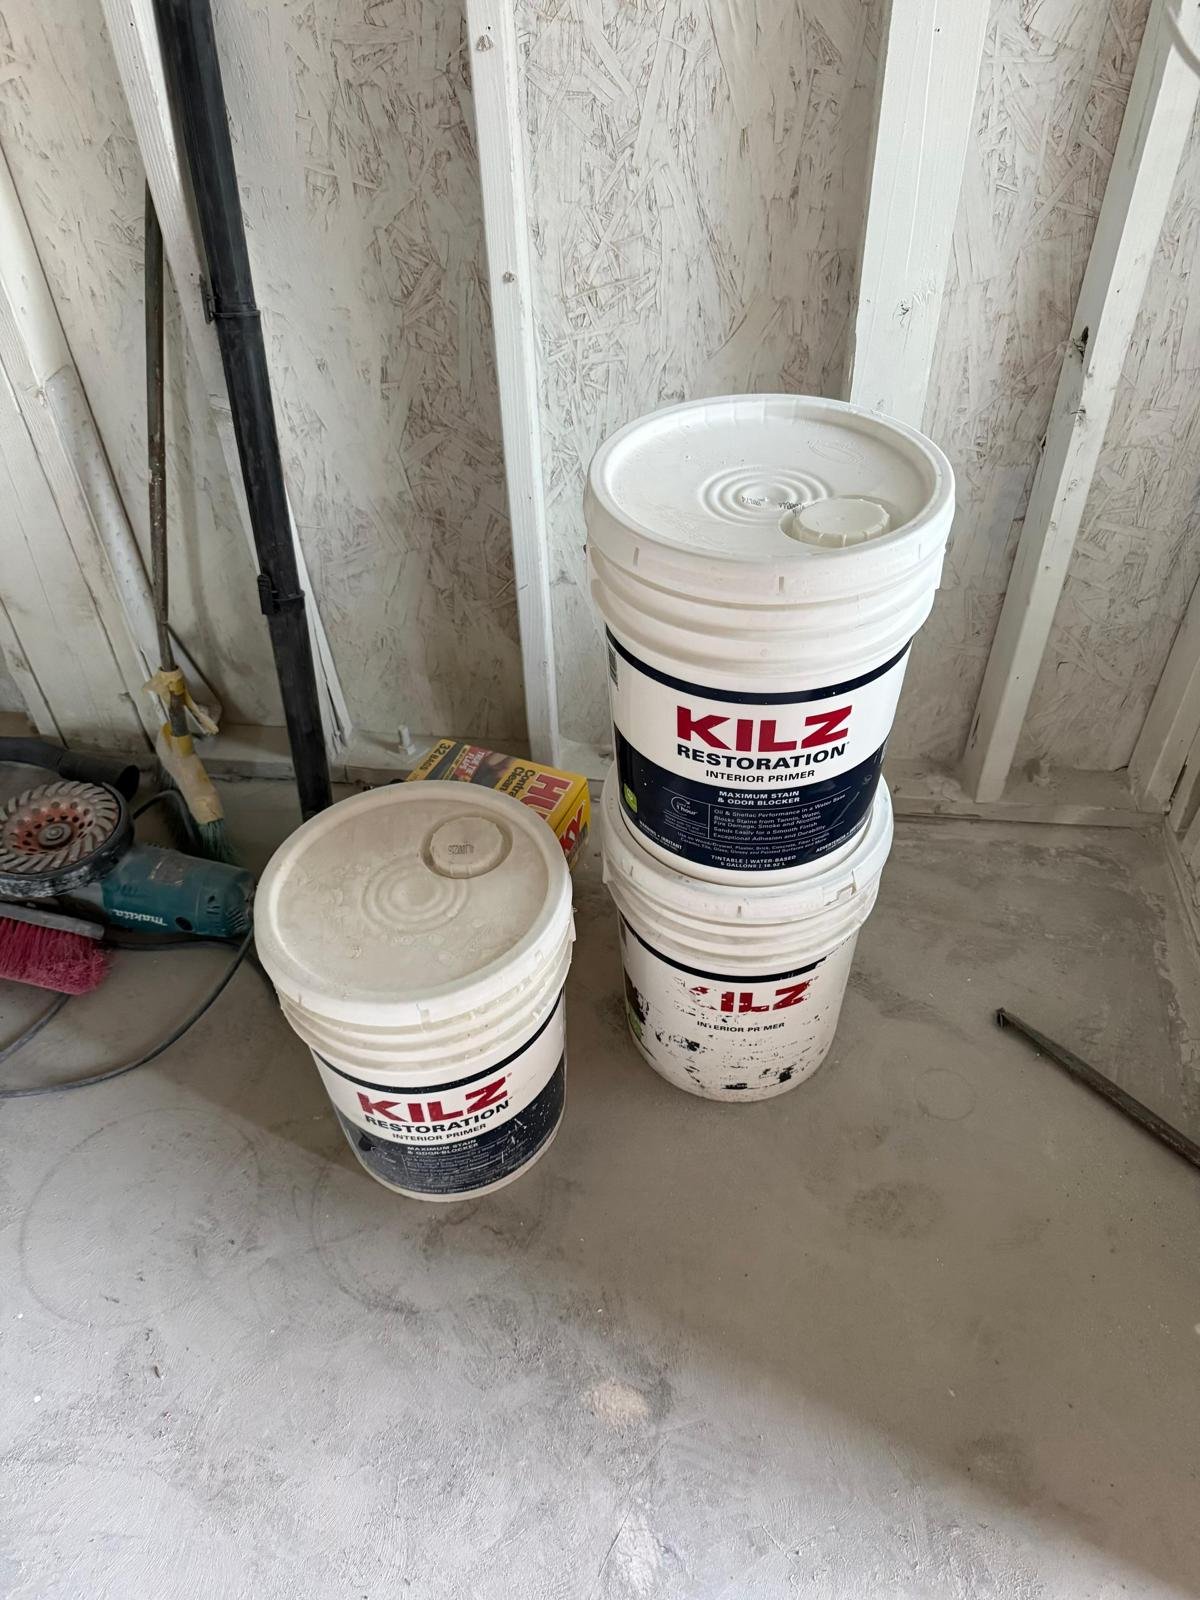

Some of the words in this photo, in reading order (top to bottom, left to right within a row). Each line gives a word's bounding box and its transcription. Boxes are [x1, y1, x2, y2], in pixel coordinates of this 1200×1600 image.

[677, 705, 852, 752] KILZ
[433, 742, 452, 755] 32
[677, 744, 847, 770] RESTORATION
[499, 766, 525, 791] Clean
[508, 769, 536, 798] Contra
[706, 769, 764, 783] INTERIOR
[768, 769, 815, 782] PRIMER
[520, 773, 573, 821] HU
[719, 790, 768, 799] MAXIMUM
[771, 790, 800, 799] STAIN
[727, 798, 755, 806] ODOR
[757, 797, 801, 806] BLOCKER
[758, 810, 800, 818] Performance
[711, 854, 744, 864] TINTABLE
[111, 908, 168, 926] makita
[748, 1022, 785, 1032] PRMER
[357, 1076, 508, 1123] KILZ
[365, 1099, 509, 1134] RESTORATION
[392, 1132, 444, 1142] INTERIOR
[446, 1123, 487, 1139] PRIMER
[452, 1139, 477, 1149] STAIN
